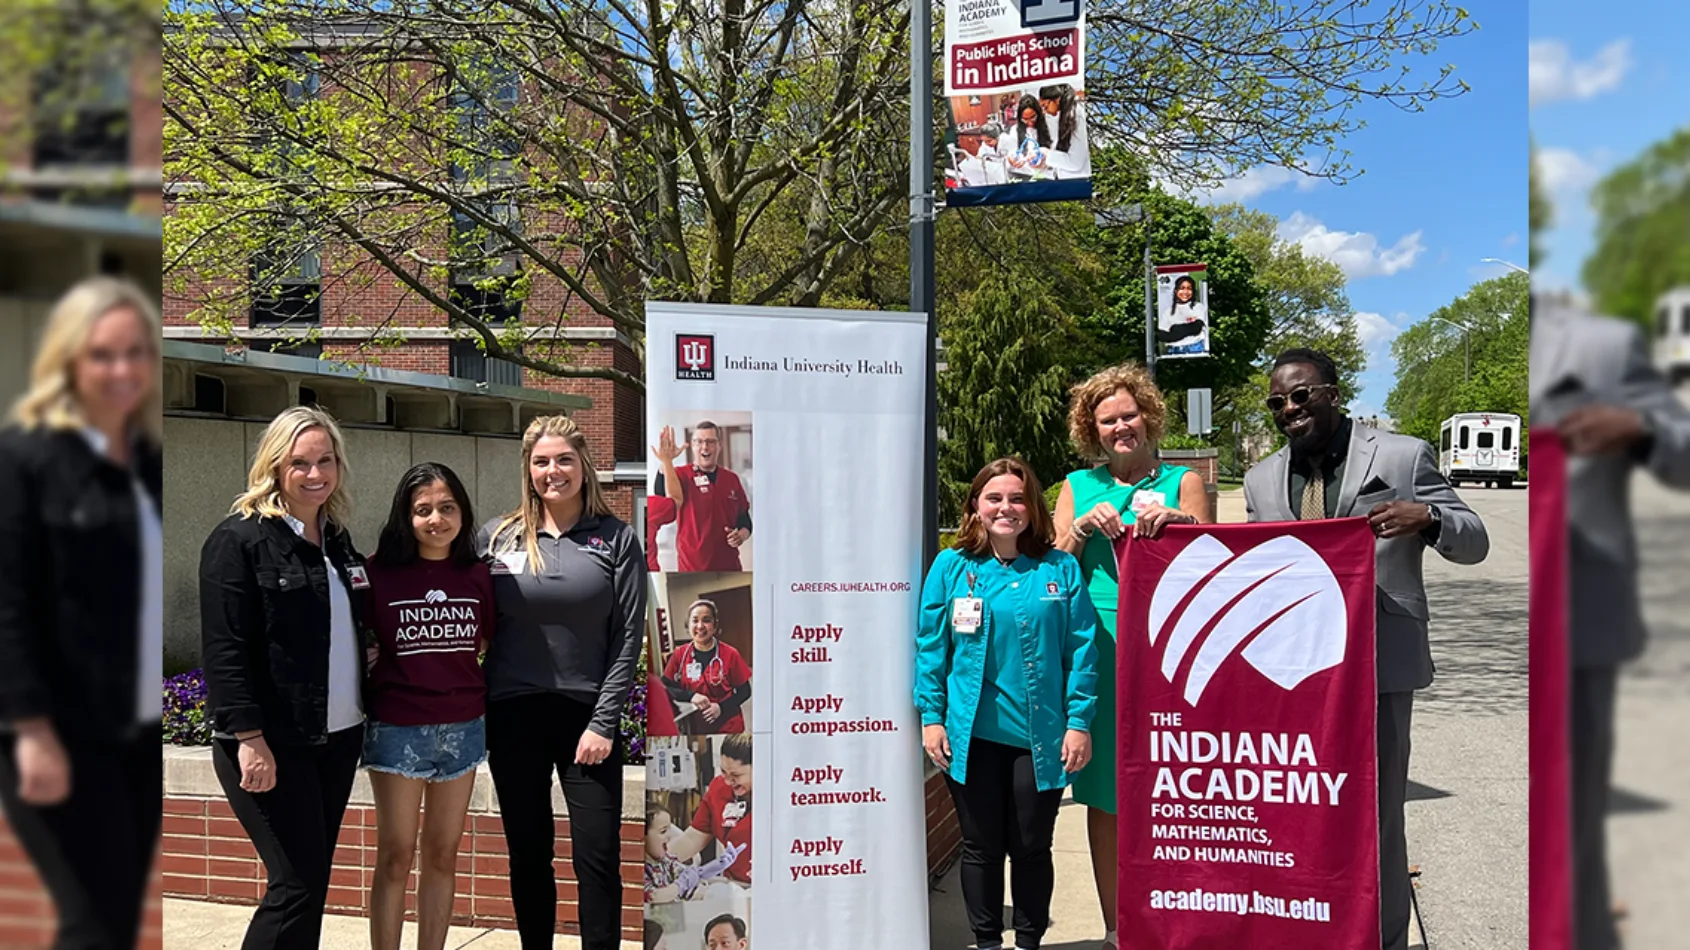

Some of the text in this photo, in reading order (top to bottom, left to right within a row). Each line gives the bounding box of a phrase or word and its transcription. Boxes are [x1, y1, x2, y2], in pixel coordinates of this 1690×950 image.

[959, 0, 1000, 12] INDIANA
[959, 6, 1007, 22] ACADEMY
[956, 33, 1073, 60] Public High School
[956, 54, 1073, 84] in Indiana
[678, 371, 712, 379] HEALTH
[724, 355, 903, 378] Indiana University Health
[791, 582, 911, 593] CAREERS.IUHEALTH.ORG
[400, 606, 476, 623] INDIANA
[395, 624, 479, 642] ACADEMY
[791, 623, 843, 643] Apply
[791, 647, 832, 663] skill.
[791, 694, 844, 714] Apply
[791, 716, 898, 736] compassion.
[1150, 712, 1182, 726] THE
[1150, 731, 1318, 767] INDIANA
[791, 765, 843, 785] Apply
[790, 787, 886, 806] teamwork.
[1151, 767, 1348, 806] ACADEMY
[1151, 803, 1259, 823] FOR SCIENCE,
[1152, 824, 1272, 846] MATHEMATICS,
[790, 836, 843, 857] Apply
[1152, 845, 1295, 868] AND HUMANITIES
[790, 858, 867, 882] yourself.
[1150, 888, 1331, 923] academy.bsu.edu
